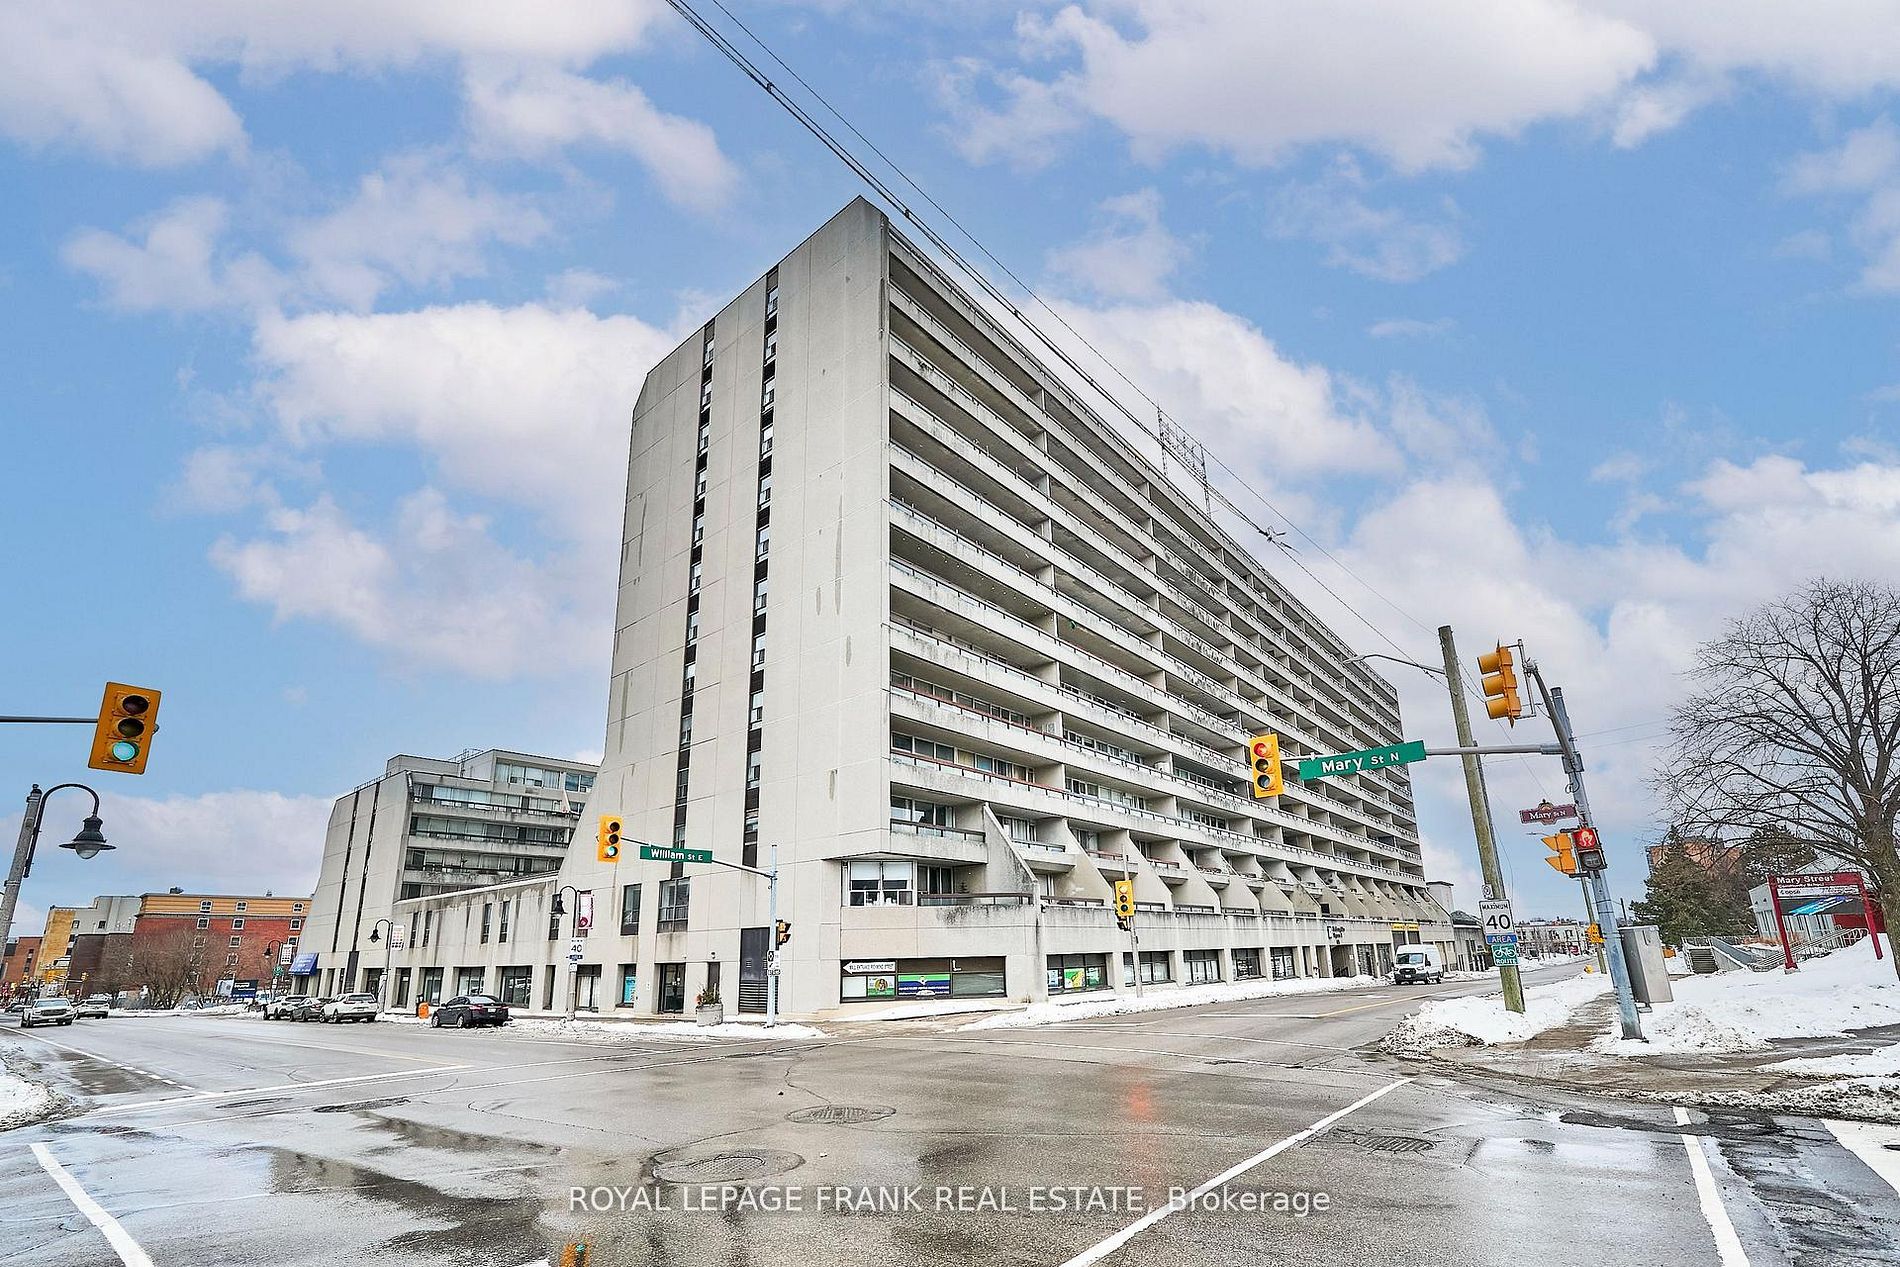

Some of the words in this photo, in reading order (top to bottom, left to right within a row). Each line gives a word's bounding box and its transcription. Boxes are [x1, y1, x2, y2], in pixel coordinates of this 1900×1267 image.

[1321, 757, 1362, 773] Mary
[1371, 755, 1384, 765] St
[1390, 752, 1399, 761] N
[1530, 812, 1552, 820] Mary
[651, 848, 684, 860] William
[1776, 876, 1801, 885] Mary
[1804, 875, 1835, 883] Street
[1486, 914, 1511, 930] 40
[1491, 935, 1513, 943] AREA
[570, 944, 583, 953] 40
